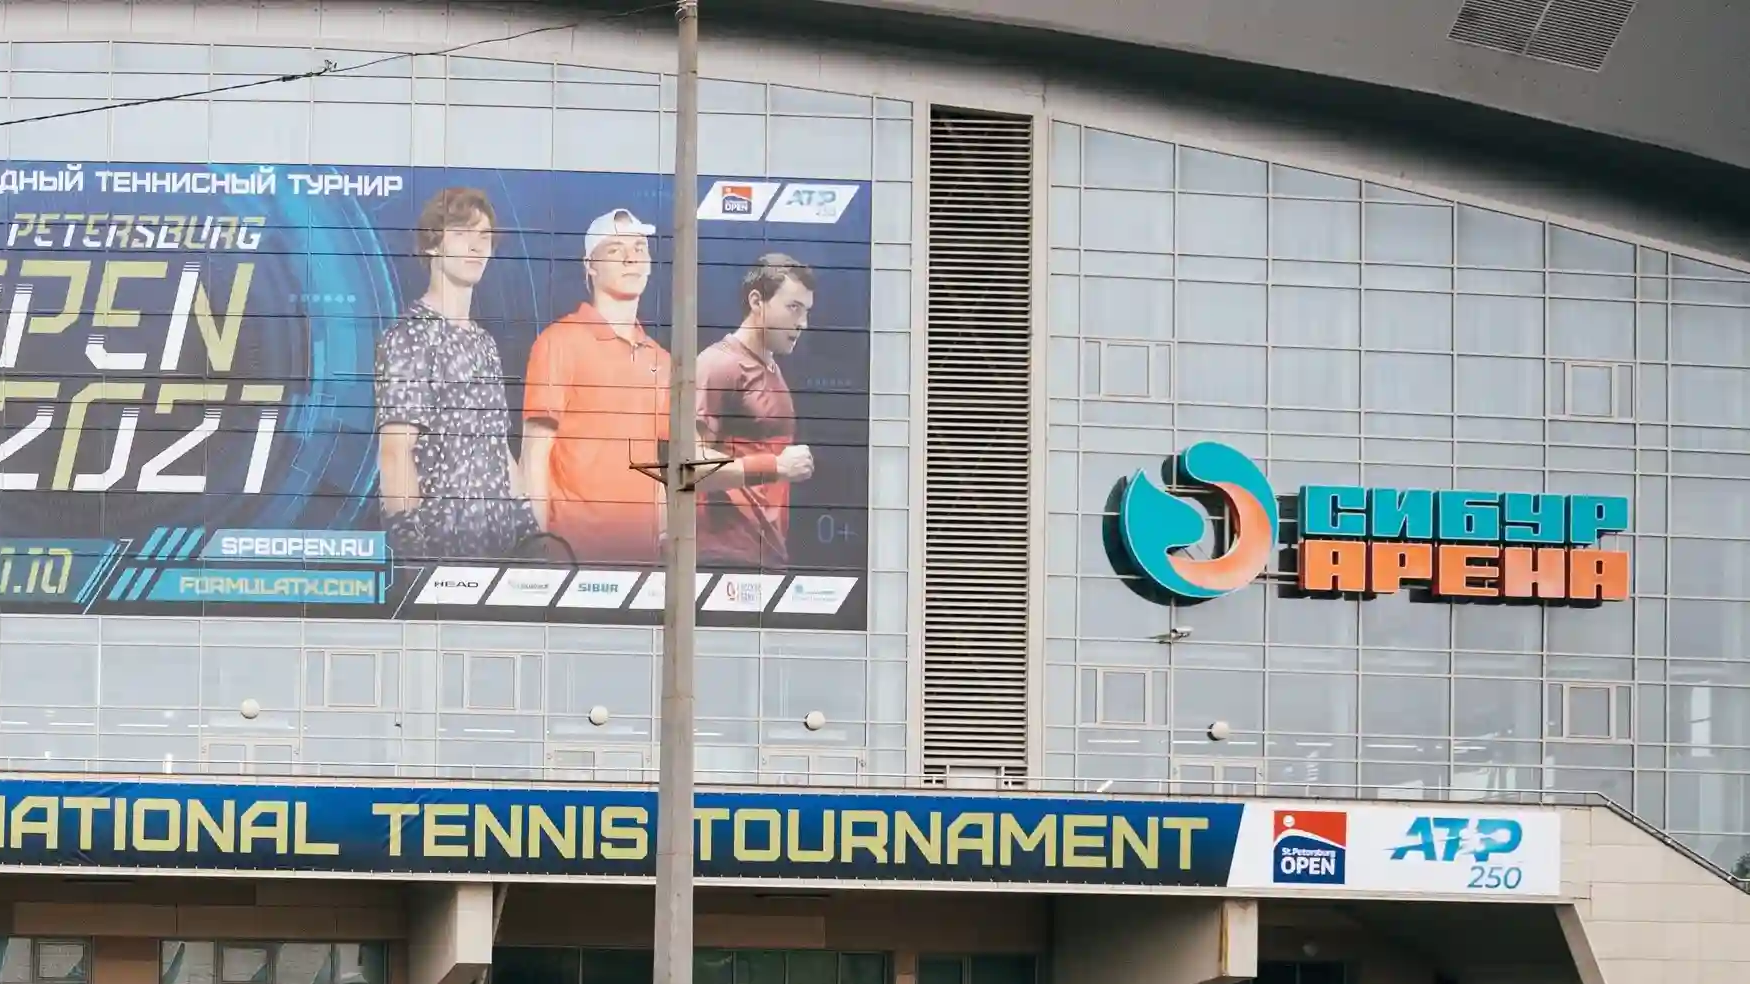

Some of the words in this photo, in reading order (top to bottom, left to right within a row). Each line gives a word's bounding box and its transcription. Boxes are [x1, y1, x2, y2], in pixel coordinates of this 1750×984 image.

[95, 166, 276, 196] ТЕННИСНЫЙ
[287, 173, 404, 198] ТУРНИР
[785, 189, 837, 206] ATP
[6, 212, 268, 251] PETERSBURG
[1300, 485, 1629, 544] СИБУР
[221, 537, 375, 558] SPBOPEN.RU
[1302, 539, 1630, 600] АРЕНА
[179, 576, 375, 598] FORMULATX.COM
[433, 580, 479, 589] HEAD
[577, 582, 619, 593] SIBUR
[371, 803, 650, 860] TENNIS
[693, 808, 1209, 871] TOURNAMENT
[1388, 816, 1523, 862] ATP
[1280, 856, 1336, 875] OPEN
[1467, 866, 1523, 890] 250
